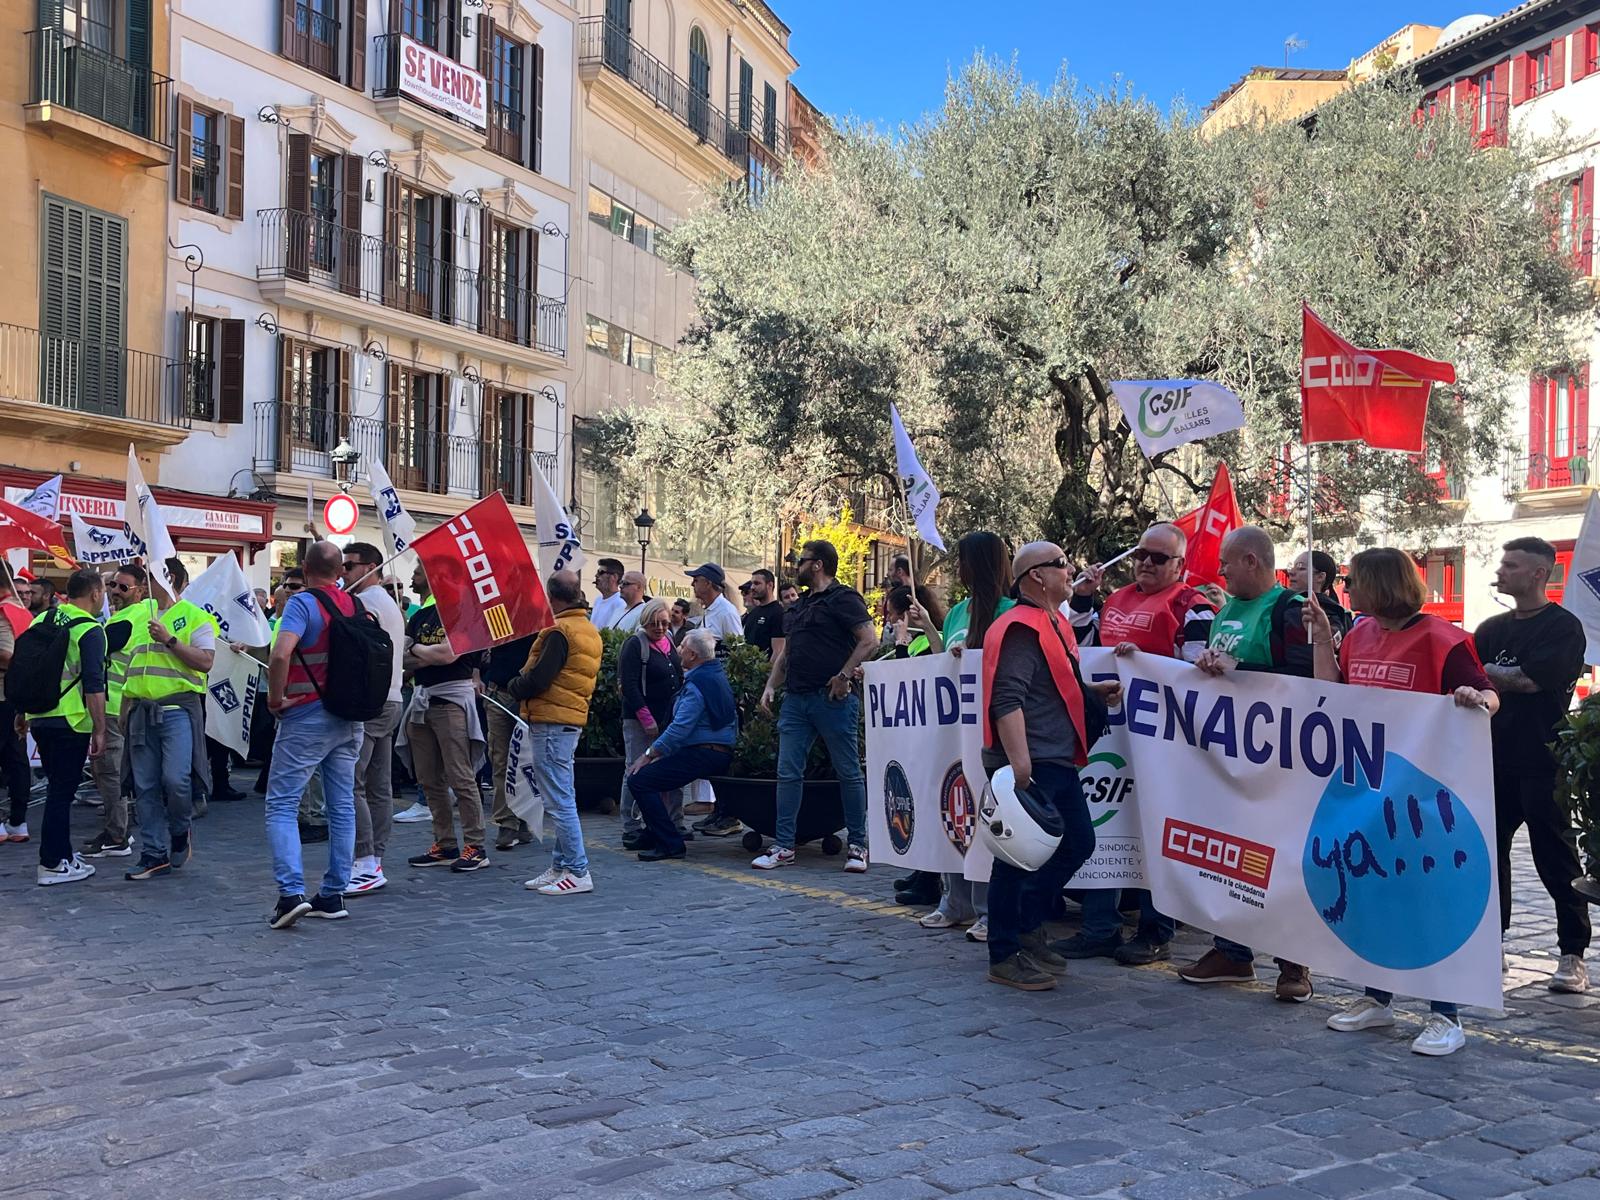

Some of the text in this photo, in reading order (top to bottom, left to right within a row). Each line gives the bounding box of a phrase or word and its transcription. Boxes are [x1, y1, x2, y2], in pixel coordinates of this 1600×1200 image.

[405, 45, 482, 110] SE VENDE
[1149, 386, 1193, 416] CSIF
[1184, 406, 1209, 420] ILLES
[1173, 417, 1211, 435] BALEARS
[60, 495, 117, 517] TISSERIA
[82, 548, 137, 563] SPPME
[447, 514, 501, 604] CCOO
[659, 579, 691, 599] Mallorca
[1349, 663, 1389, 680] CCOO
[242, 673, 258, 745] SPPME
[869, 677, 927, 728] PLAN
[934, 673, 977, 726] DE
[506, 725, 524, 797] SPPME
[1080, 776, 1135, 803] CSIF
[1099, 843, 1141, 853] SINDICAL
[1168, 827, 1242, 870] CCOO
[1084, 857, 1135, 866] ENDIENTE
[1073, 870, 1144, 880] FUNCIONARIOS
[1198, 870, 1223, 884] serveis
[1234, 881, 1266, 899] ciutadania
[1241, 894, 1265, 910] balears
